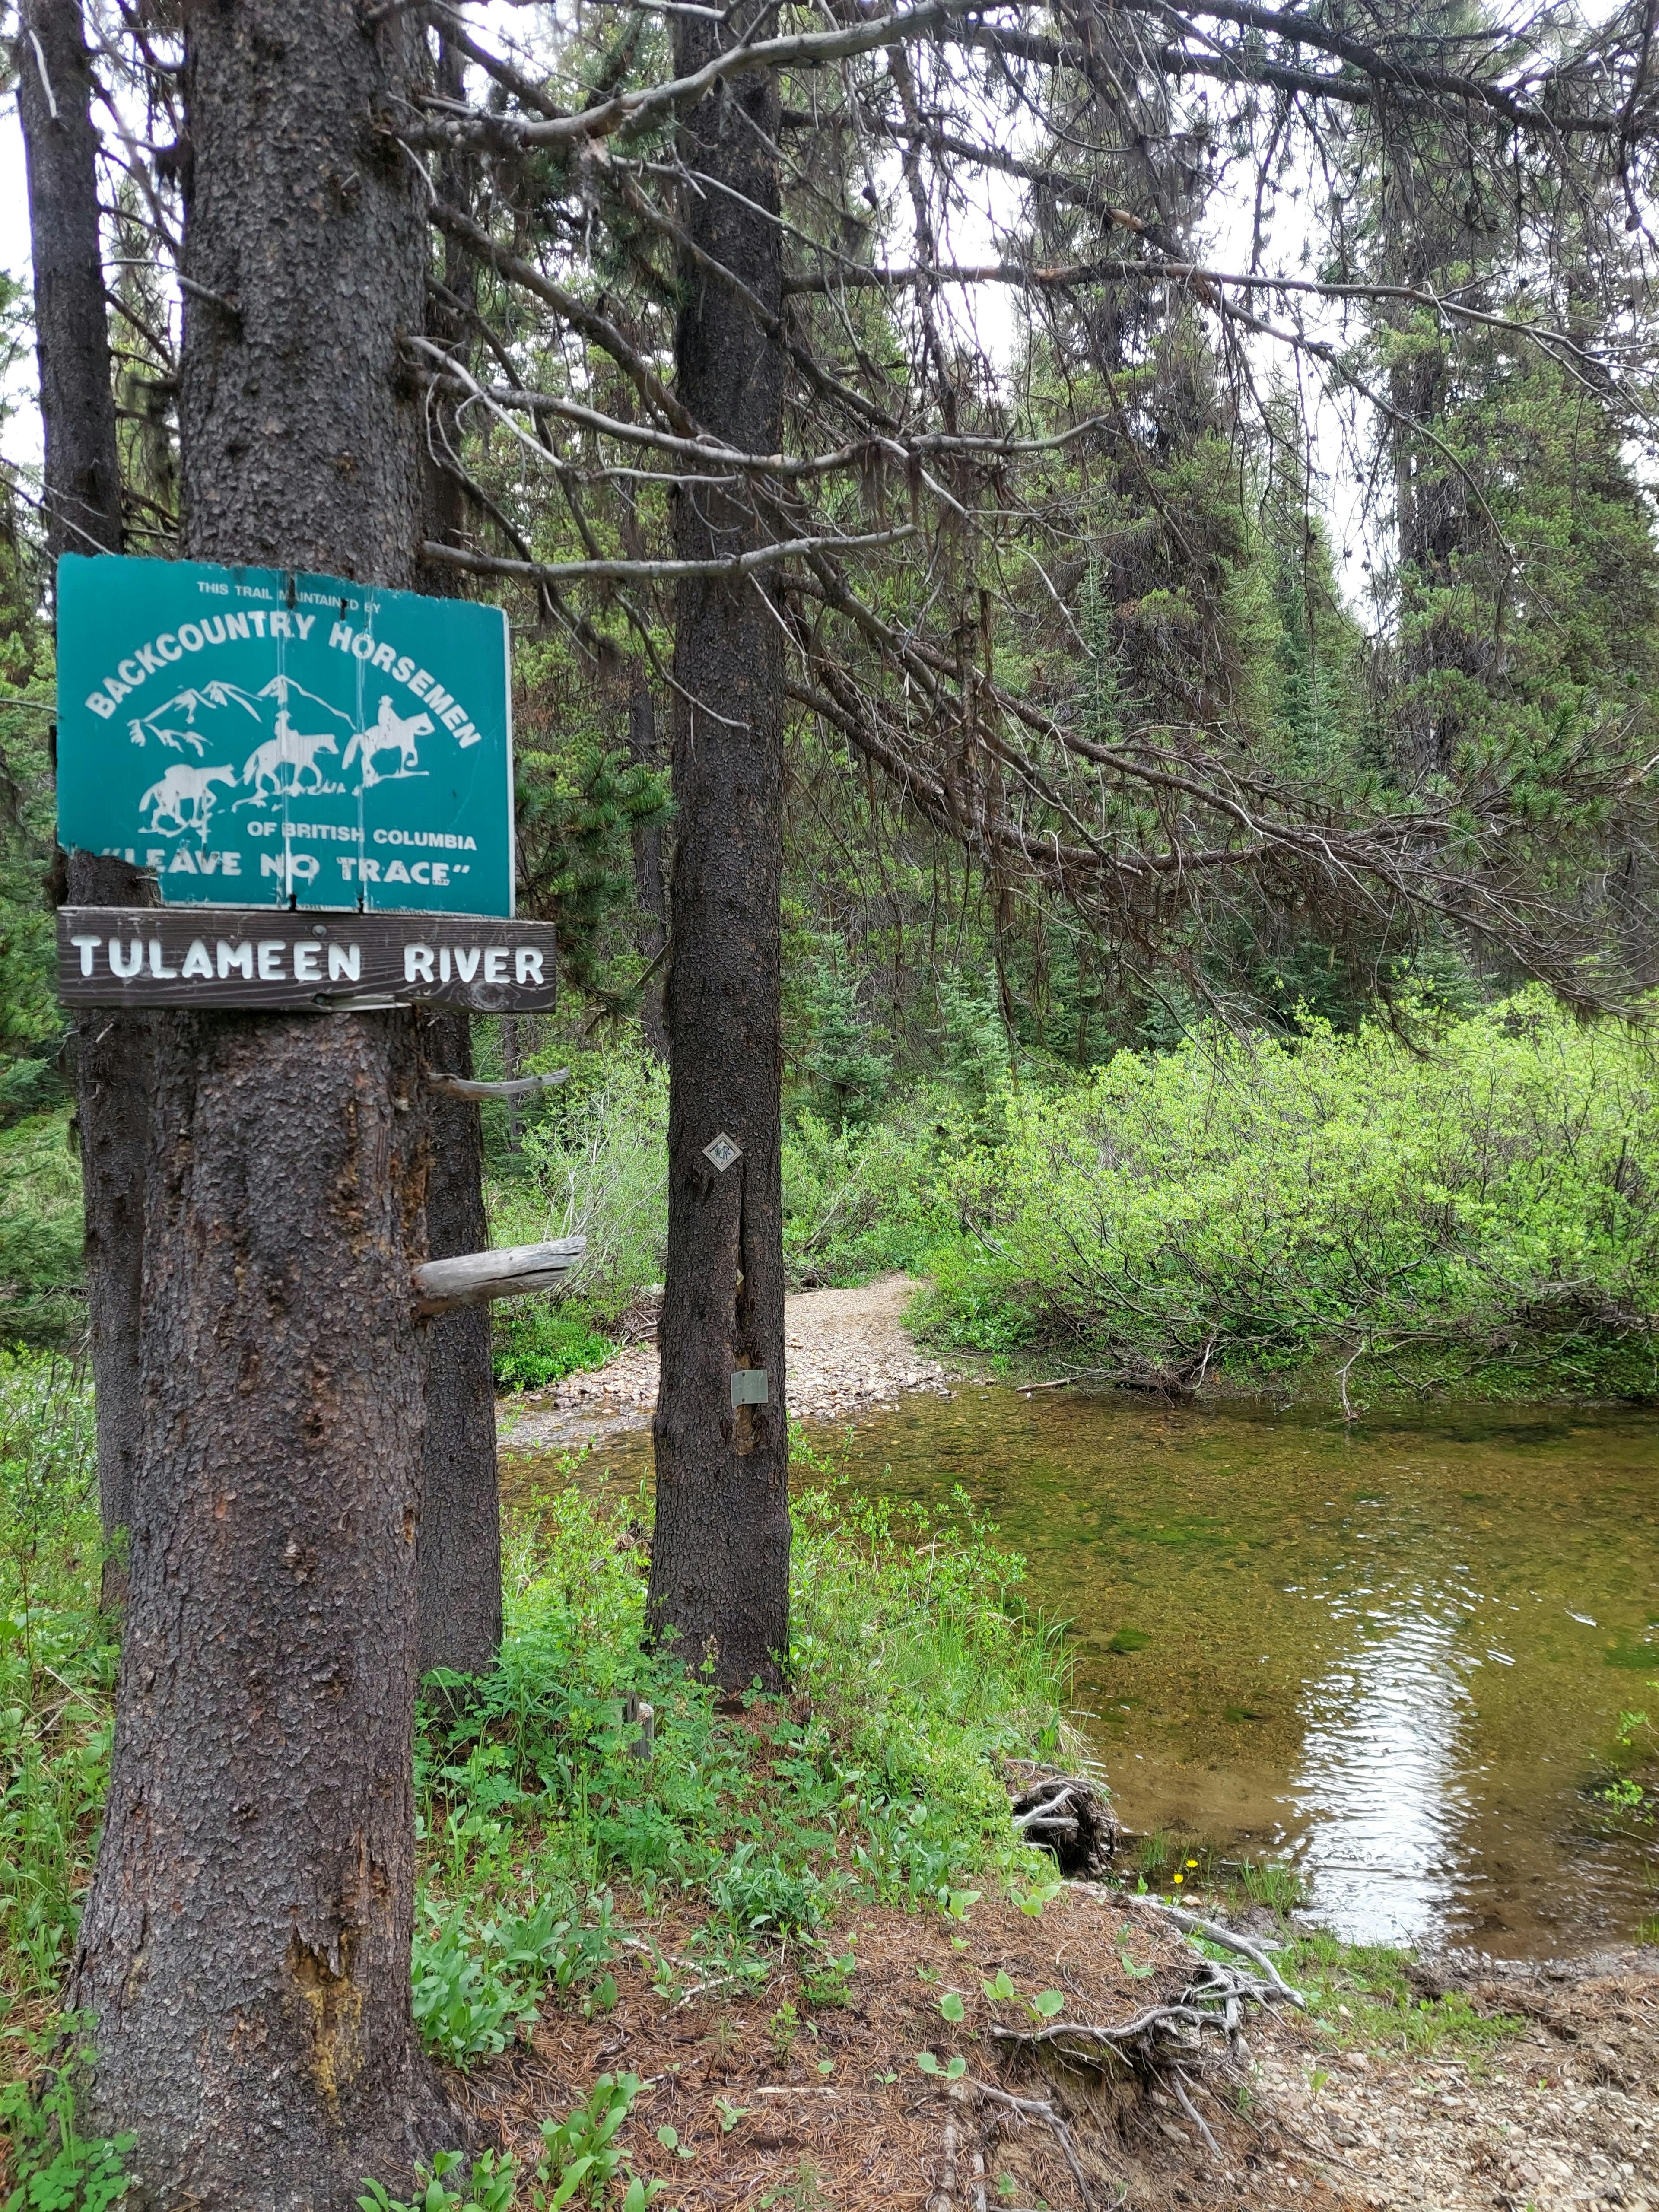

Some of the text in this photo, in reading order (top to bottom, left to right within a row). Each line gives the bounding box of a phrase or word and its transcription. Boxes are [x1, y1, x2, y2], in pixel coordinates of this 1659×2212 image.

[197, 581, 381, 614] THIS TRAIL MINTAIND BY
[85, 610, 482, 749] BACKCOUNTRY HORSEMEN
[247, 821, 477, 851] OF BRITISH COLUMBIA
[260, 853, 320, 878] NO
[70, 935, 544, 984] TULAMEEN RIVER
